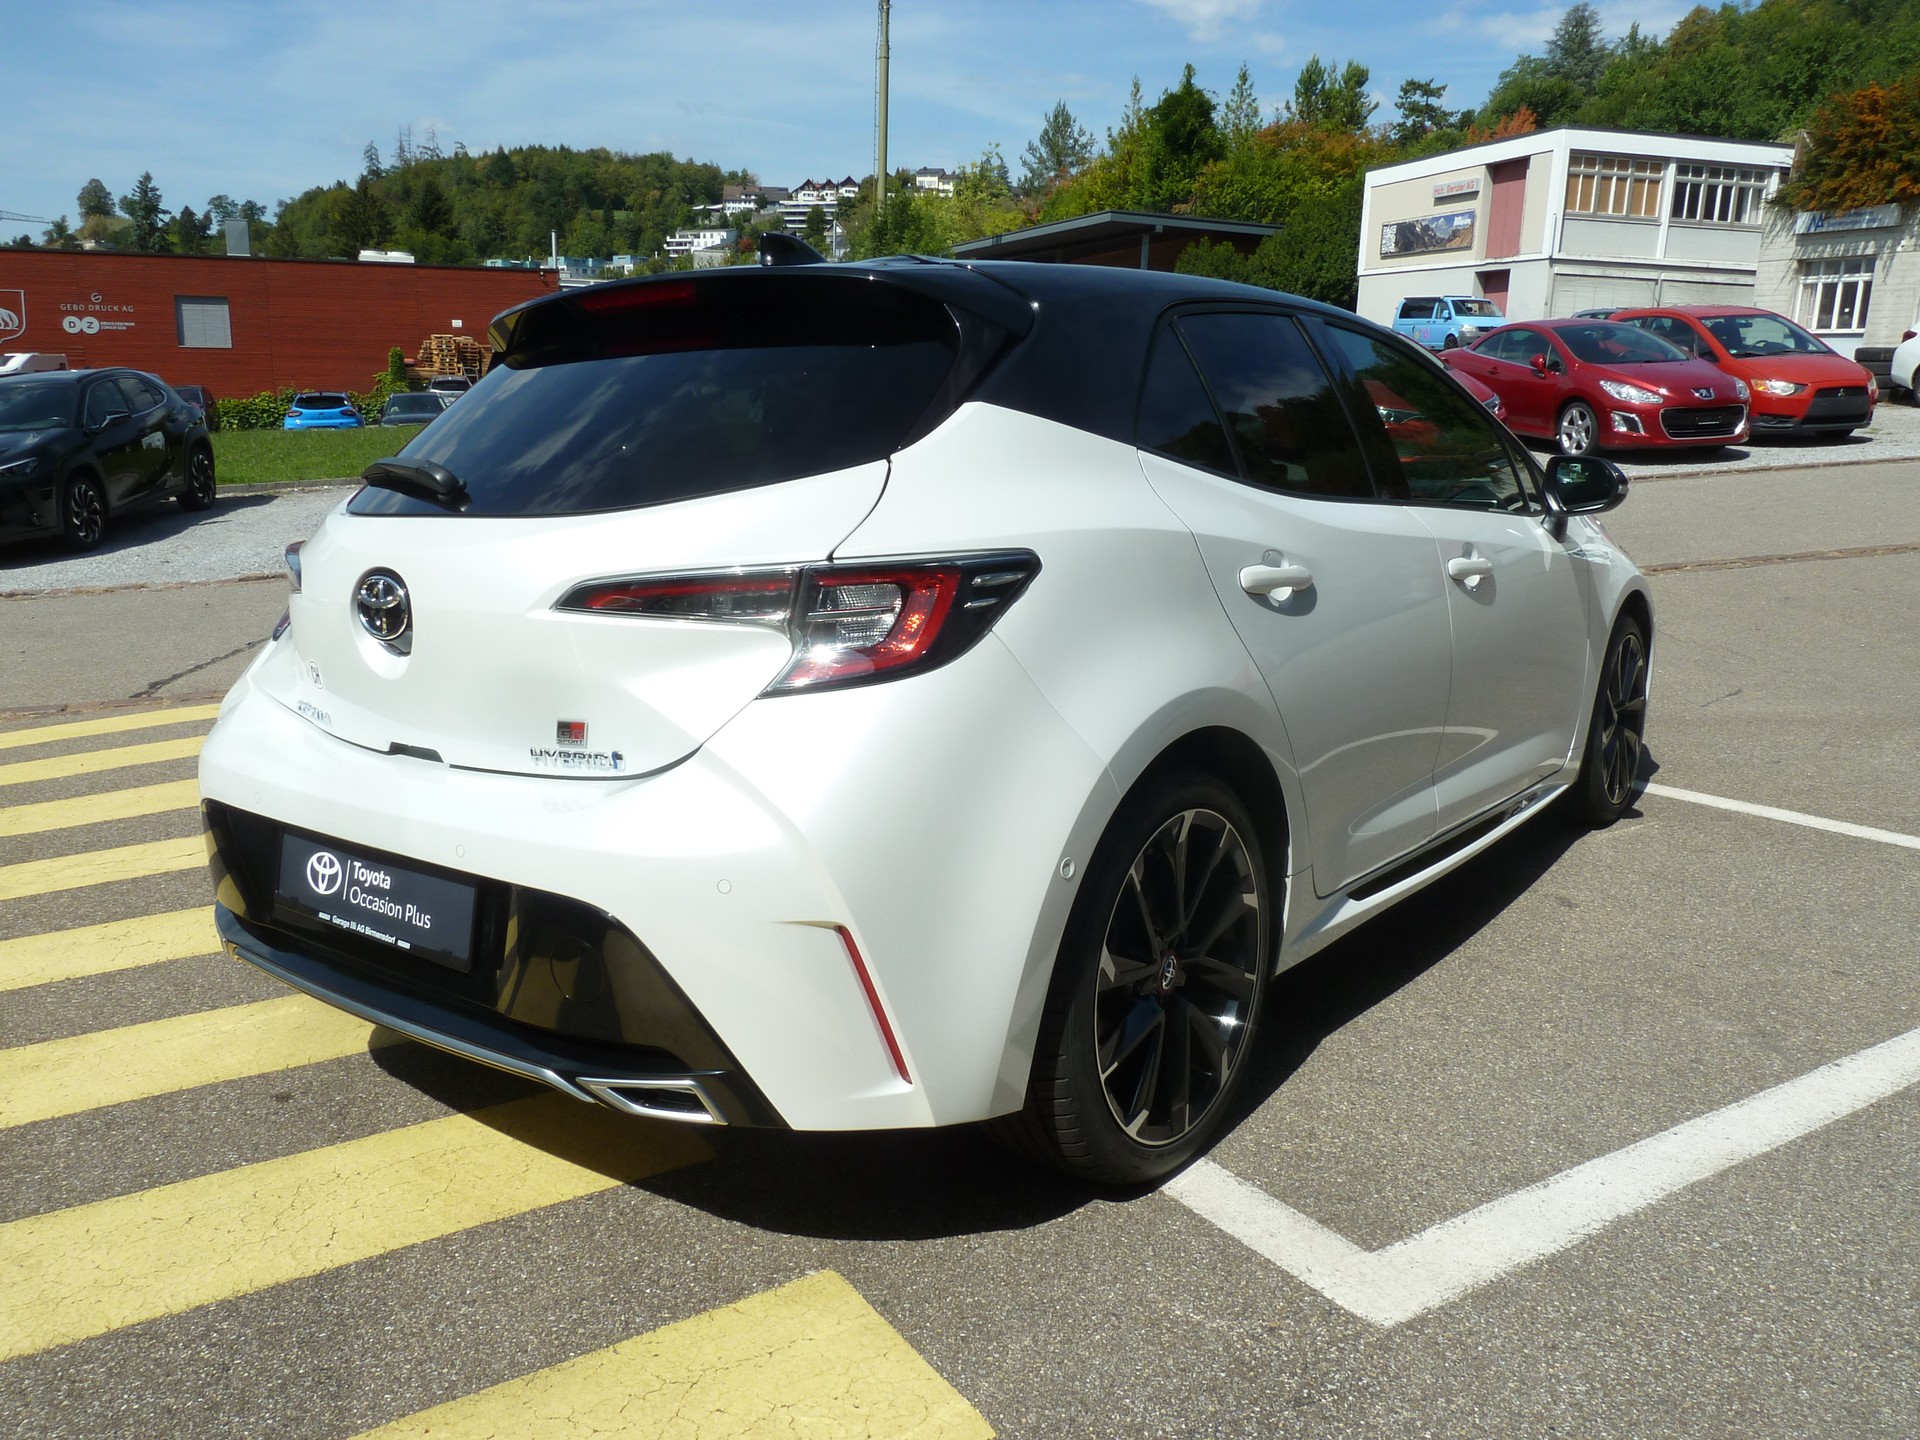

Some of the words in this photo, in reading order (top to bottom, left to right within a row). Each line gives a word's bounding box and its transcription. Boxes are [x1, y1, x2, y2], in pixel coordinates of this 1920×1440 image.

[1466, 180, 1474, 189] AG
[60, 303, 85, 311] GEBO
[88, 304, 119, 312] DRUCK
[353, 861, 391, 890] Toyota
[350, 886, 402, 920] Occasion
[405, 904, 431, 929] Plus
[332, 915, 350, 929] Garage
[356, 923, 365, 934] AG
